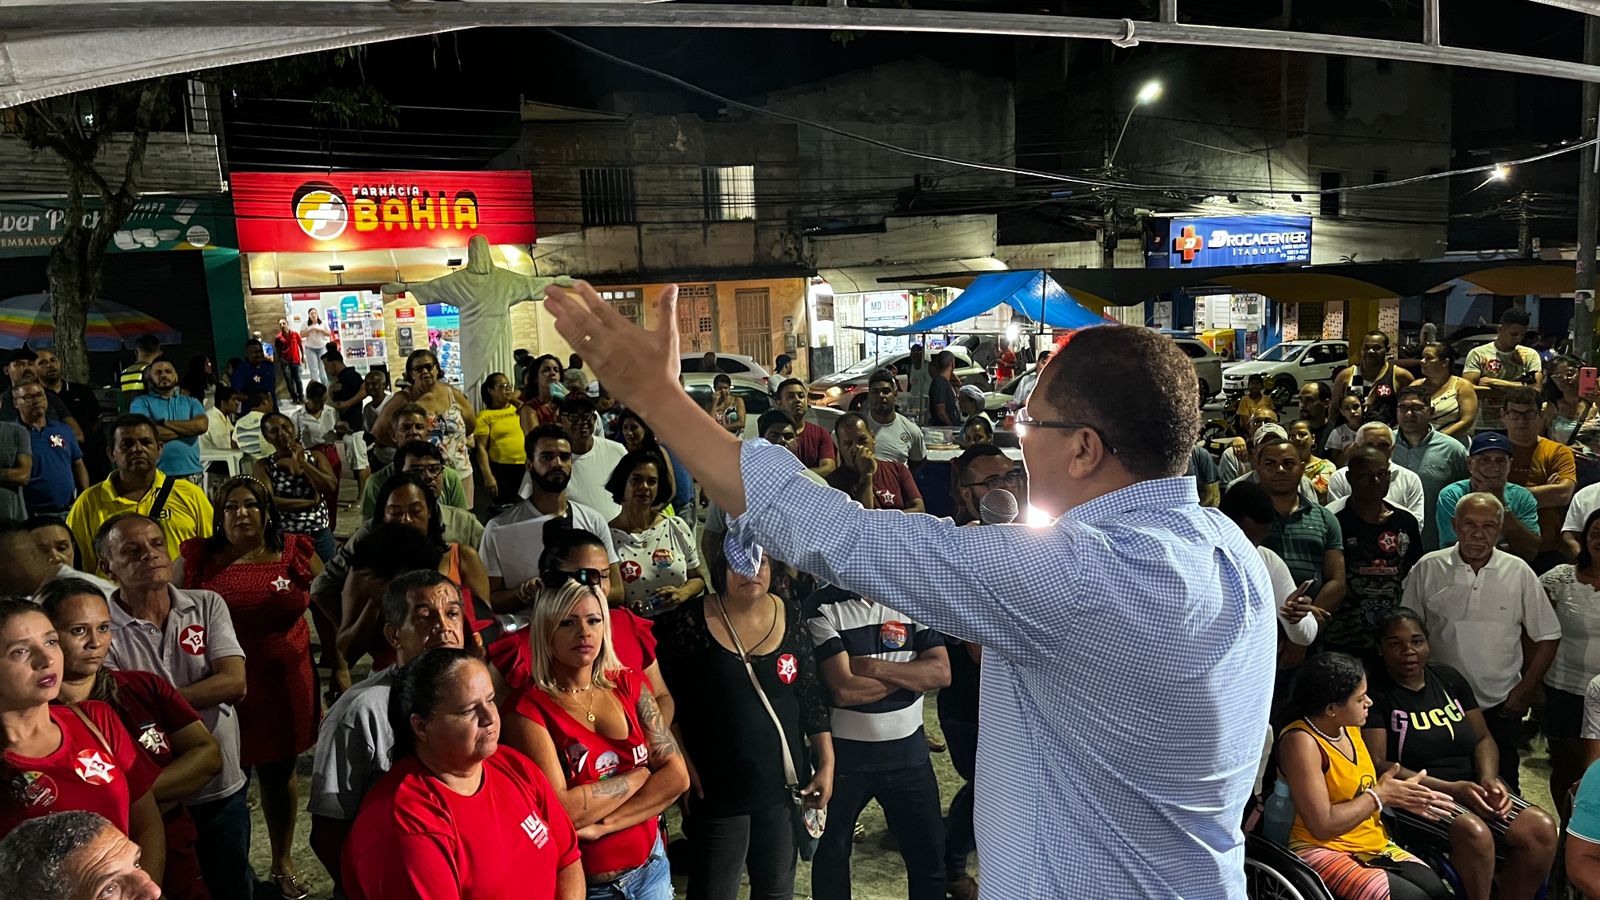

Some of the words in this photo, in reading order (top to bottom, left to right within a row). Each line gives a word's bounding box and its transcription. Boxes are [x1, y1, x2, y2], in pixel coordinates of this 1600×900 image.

[352, 184, 419, 196] FARMÁCIA
[45, 209, 101, 230] Pck
[353, 197, 478, 232] BAHIA
[1207, 230, 1307, 248] DROGACENTER
[1233, 247, 1281, 256] ITABUNA
[277, 580, 287, 588] 13
[189, 634, 202, 646] 13
[784, 662, 794, 675] 13
[149, 732, 162, 744] 13
[89, 760, 106, 771] 13
